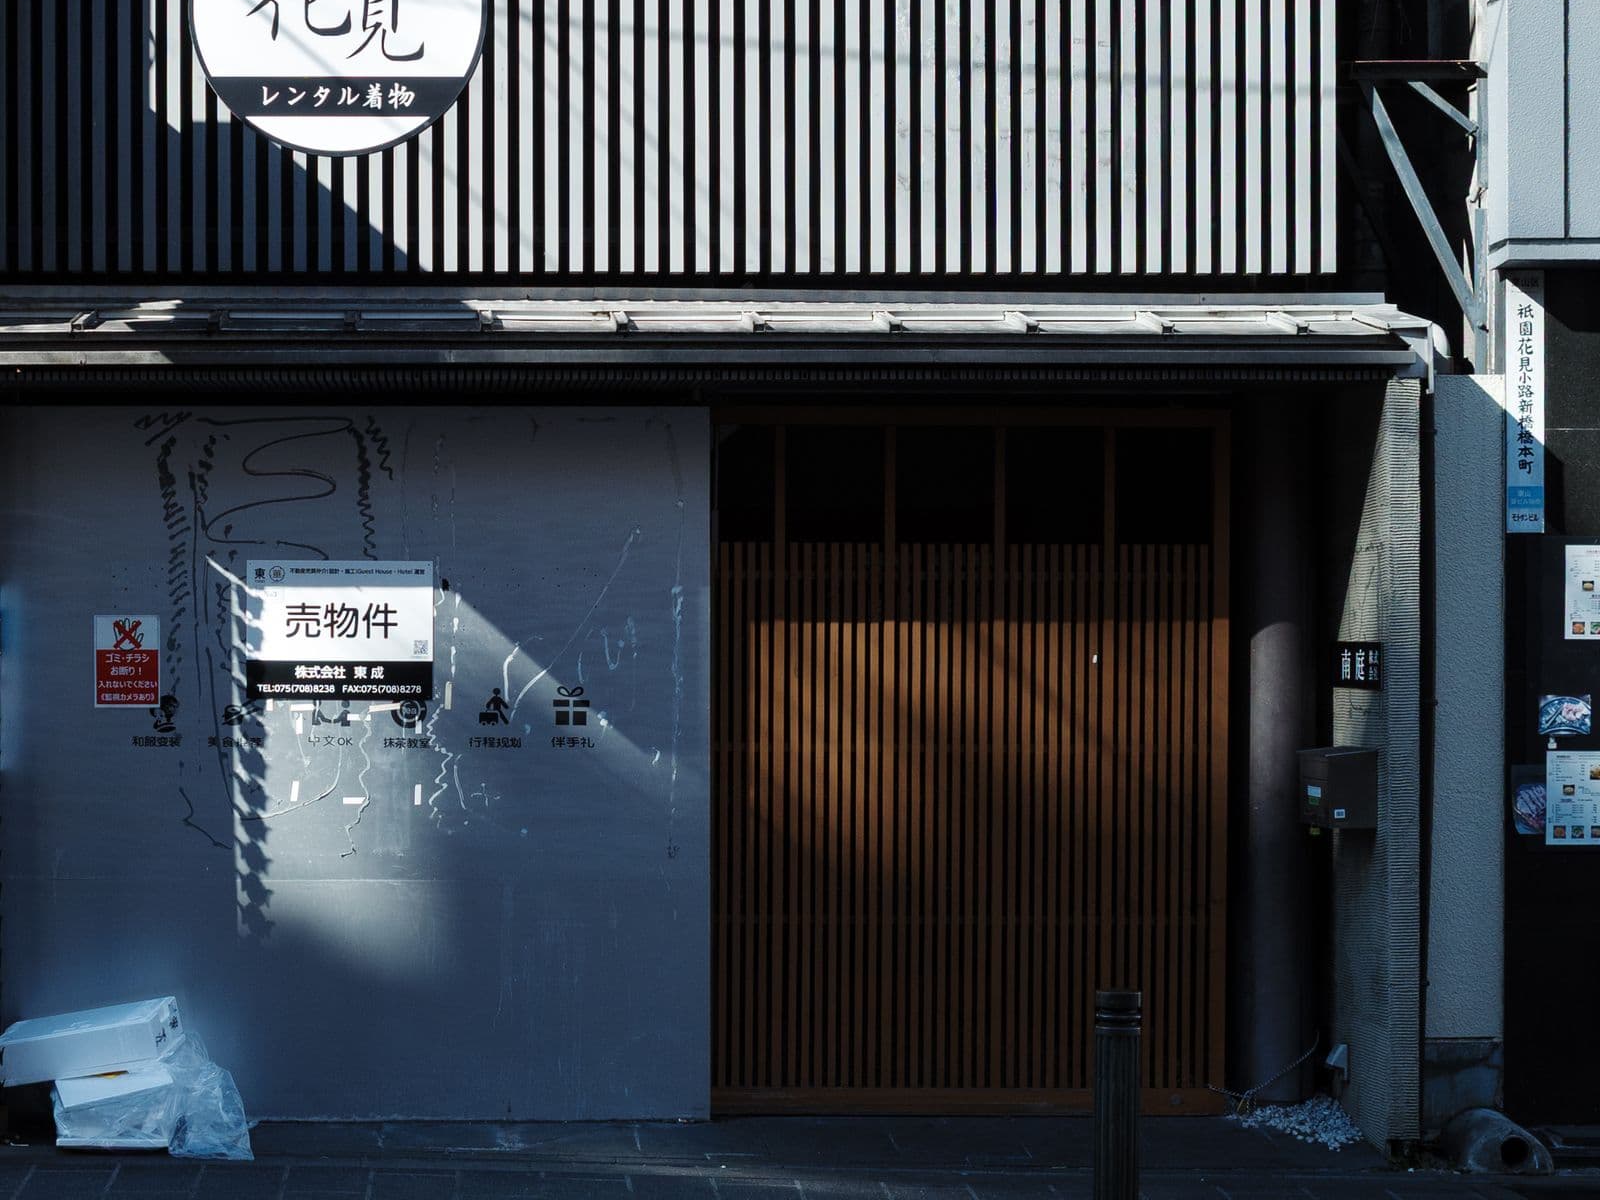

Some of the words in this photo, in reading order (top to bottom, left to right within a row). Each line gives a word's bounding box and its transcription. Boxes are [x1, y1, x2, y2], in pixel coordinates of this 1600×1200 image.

[261, 83, 416, 110] レンタル着物
[285, 601, 399, 640] 売物件
[1340, 648, 1366, 681] 南庭
[294, 665, 346, 680] 株式会社
[98, 680, 158, 689] 入れないでください
[257, 683, 336, 695] TEL:075(708)8238
[342, 683, 422, 695] FAX:075(708)8278
[383, 736, 432, 749] 抹茶教室
[469, 736, 522, 749] 行程规划
[551, 736, 595, 749] 伴手礼
